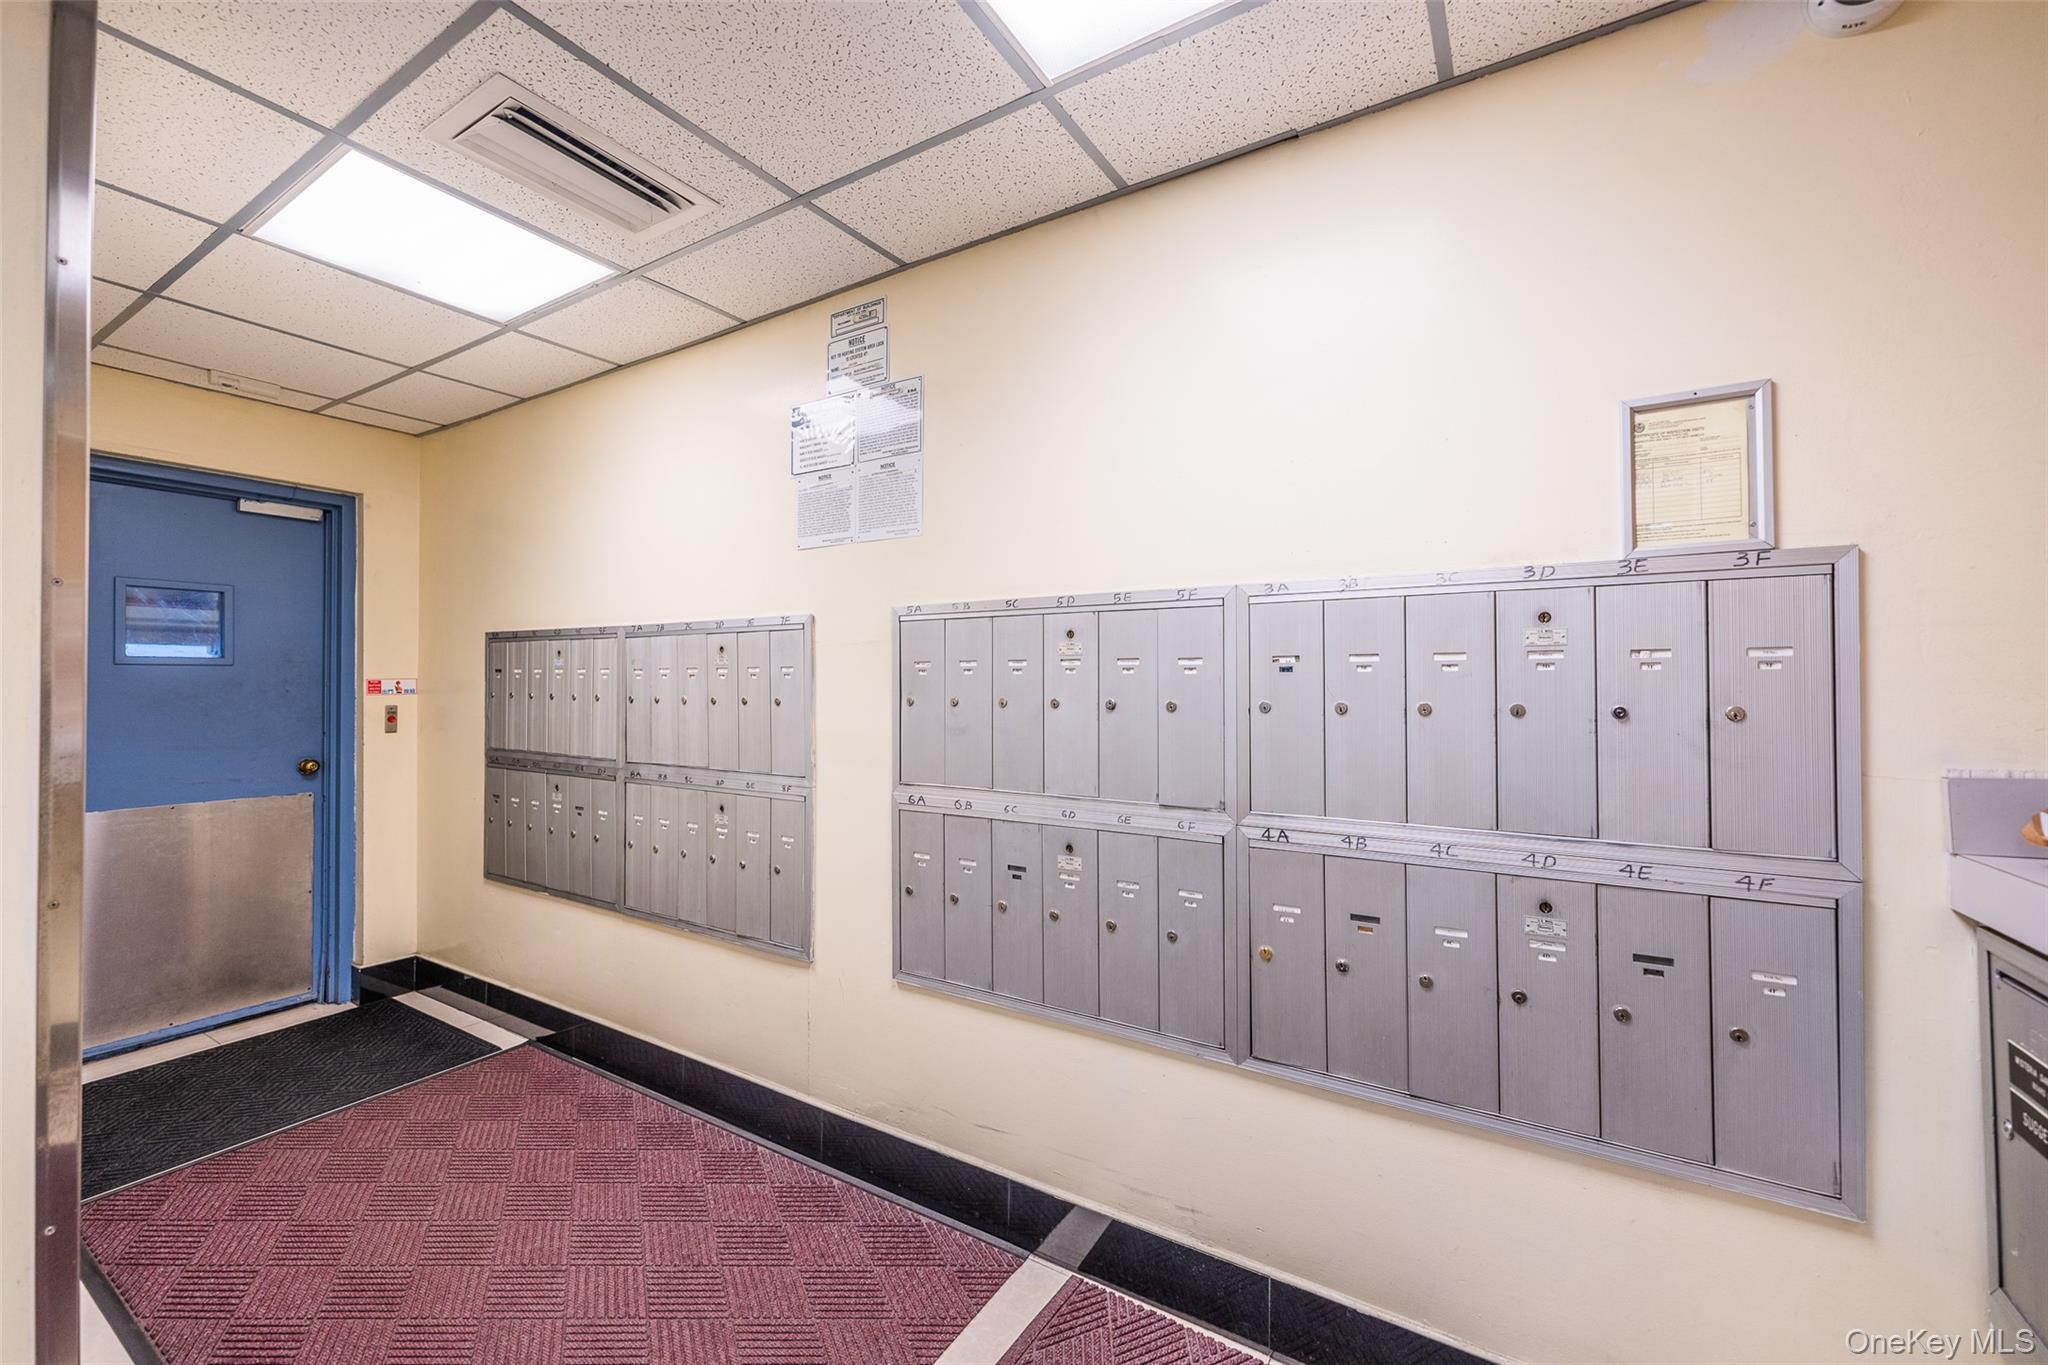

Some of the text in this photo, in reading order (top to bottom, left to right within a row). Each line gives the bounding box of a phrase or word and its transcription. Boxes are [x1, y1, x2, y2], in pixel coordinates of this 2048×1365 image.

[848, 335, 866, 347] NOTICE
[1732, 550, 1772, 568] 3F
[1522, 564, 1556, 580] 3D
[1616, 558, 1650, 575] 3E
[1176, 588, 1198, 601] 5F
[1263, 583, 1290, 595] 3A
[1005, 598, 1018, 608] 5C
[1056, 596, 1075, 608] 5D
[1113, 592, 1132, 605] 5E
[906, 605, 923, 615] 5A
[952, 602, 971, 611] 5B
[780, 615, 791, 626] 7F
[631, 624, 644, 634] 7A
[908, 795, 926, 806] 6A
[954, 799, 973, 810] 6B
[1004, 805, 1018, 814] 6C
[1260, 827, 1289, 844] 4A
[1339, 835, 1367, 851] 4B
[1427, 842, 1459, 858] 4C
[1520, 853, 1557, 870] 4D
[1617, 864, 1653, 881] 4E
[1734, 874, 1776, 893] 4F
